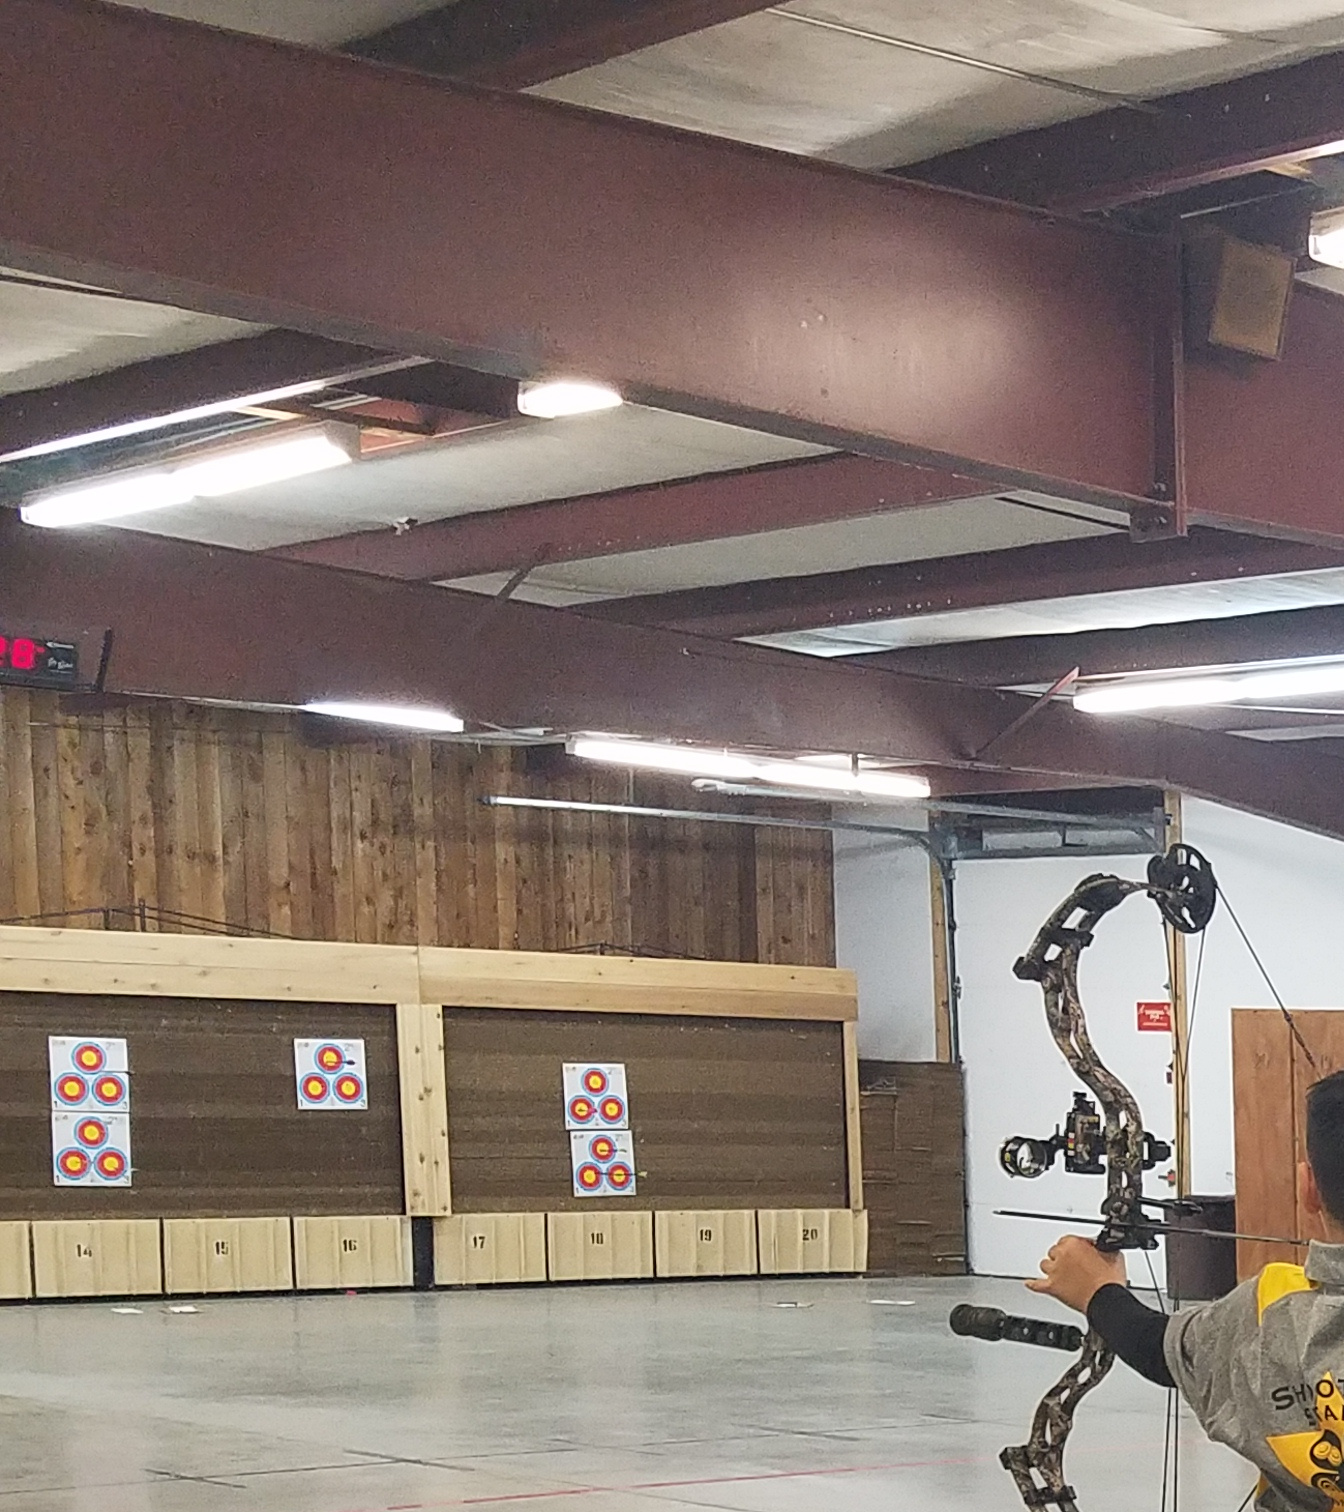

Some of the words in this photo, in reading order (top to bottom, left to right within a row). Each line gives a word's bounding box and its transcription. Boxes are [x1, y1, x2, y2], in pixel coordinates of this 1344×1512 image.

[472, 1235, 486, 1249] 17
[699, 1228, 713, 1242] 19
[802, 1228, 818, 1242] 20
[76, 1244, 93, 1258] 14
[215, 1241, 229, 1255] 15
[342, 1239, 358, 1252] 16
